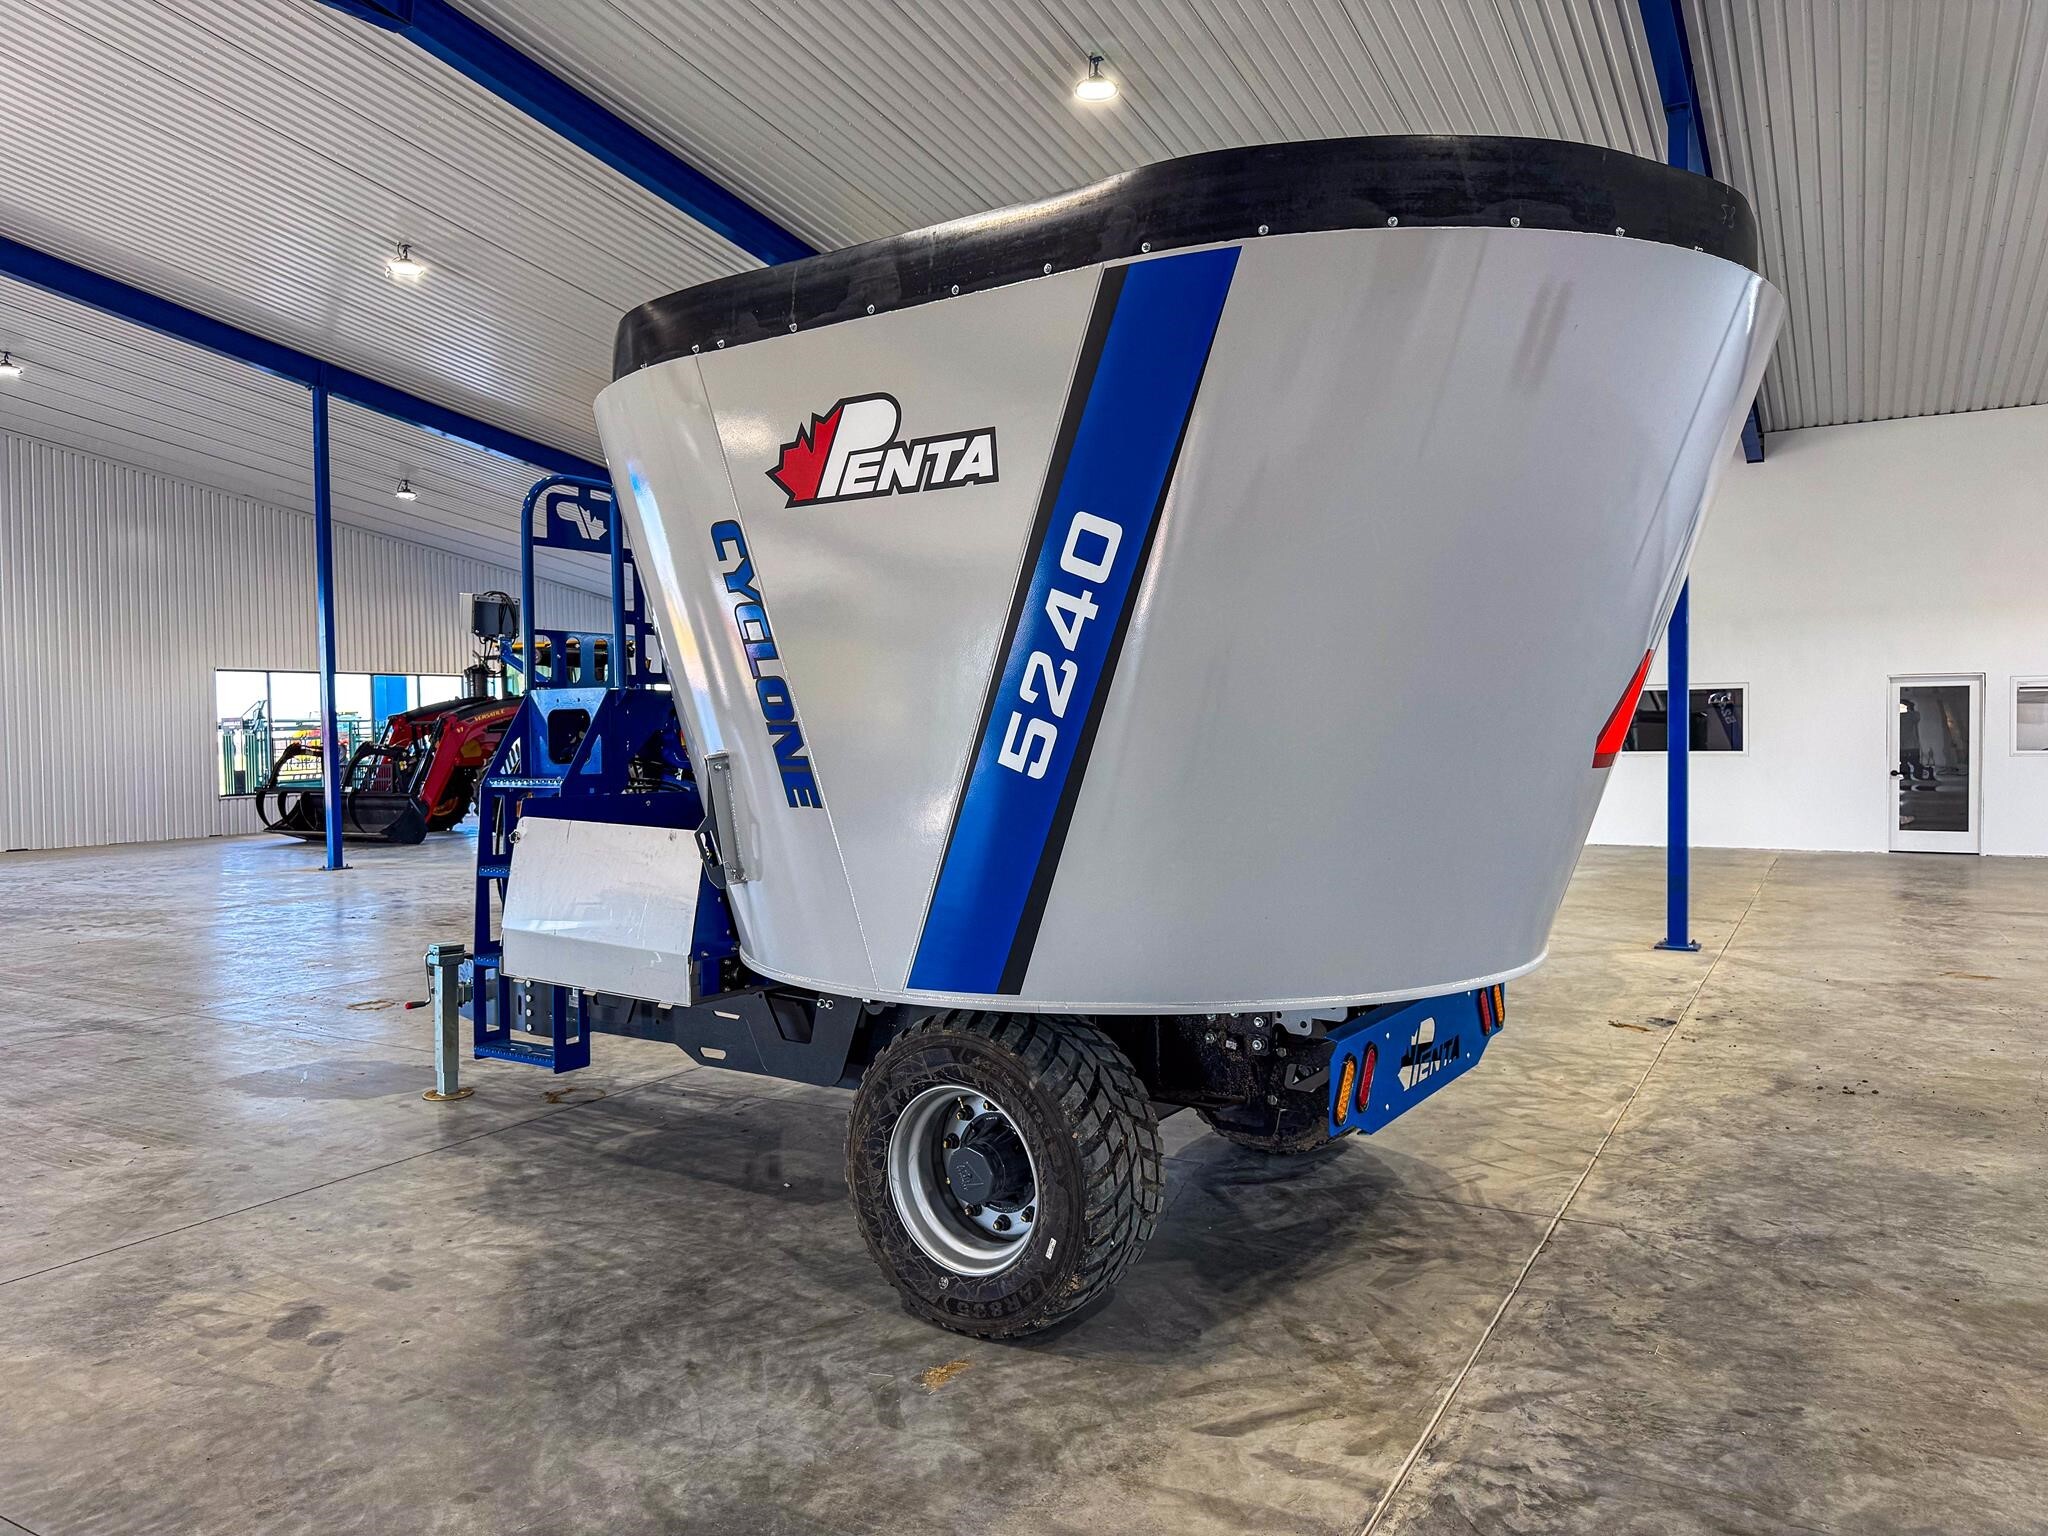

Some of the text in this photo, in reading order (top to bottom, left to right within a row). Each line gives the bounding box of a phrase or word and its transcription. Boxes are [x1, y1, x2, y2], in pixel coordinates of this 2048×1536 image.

[816, 396, 996, 501] PENTA
[710, 519, 824, 809] CYCLONE
[998, 511, 1123, 780] 5240
[1411, 1017, 1460, 1087] PENTA
